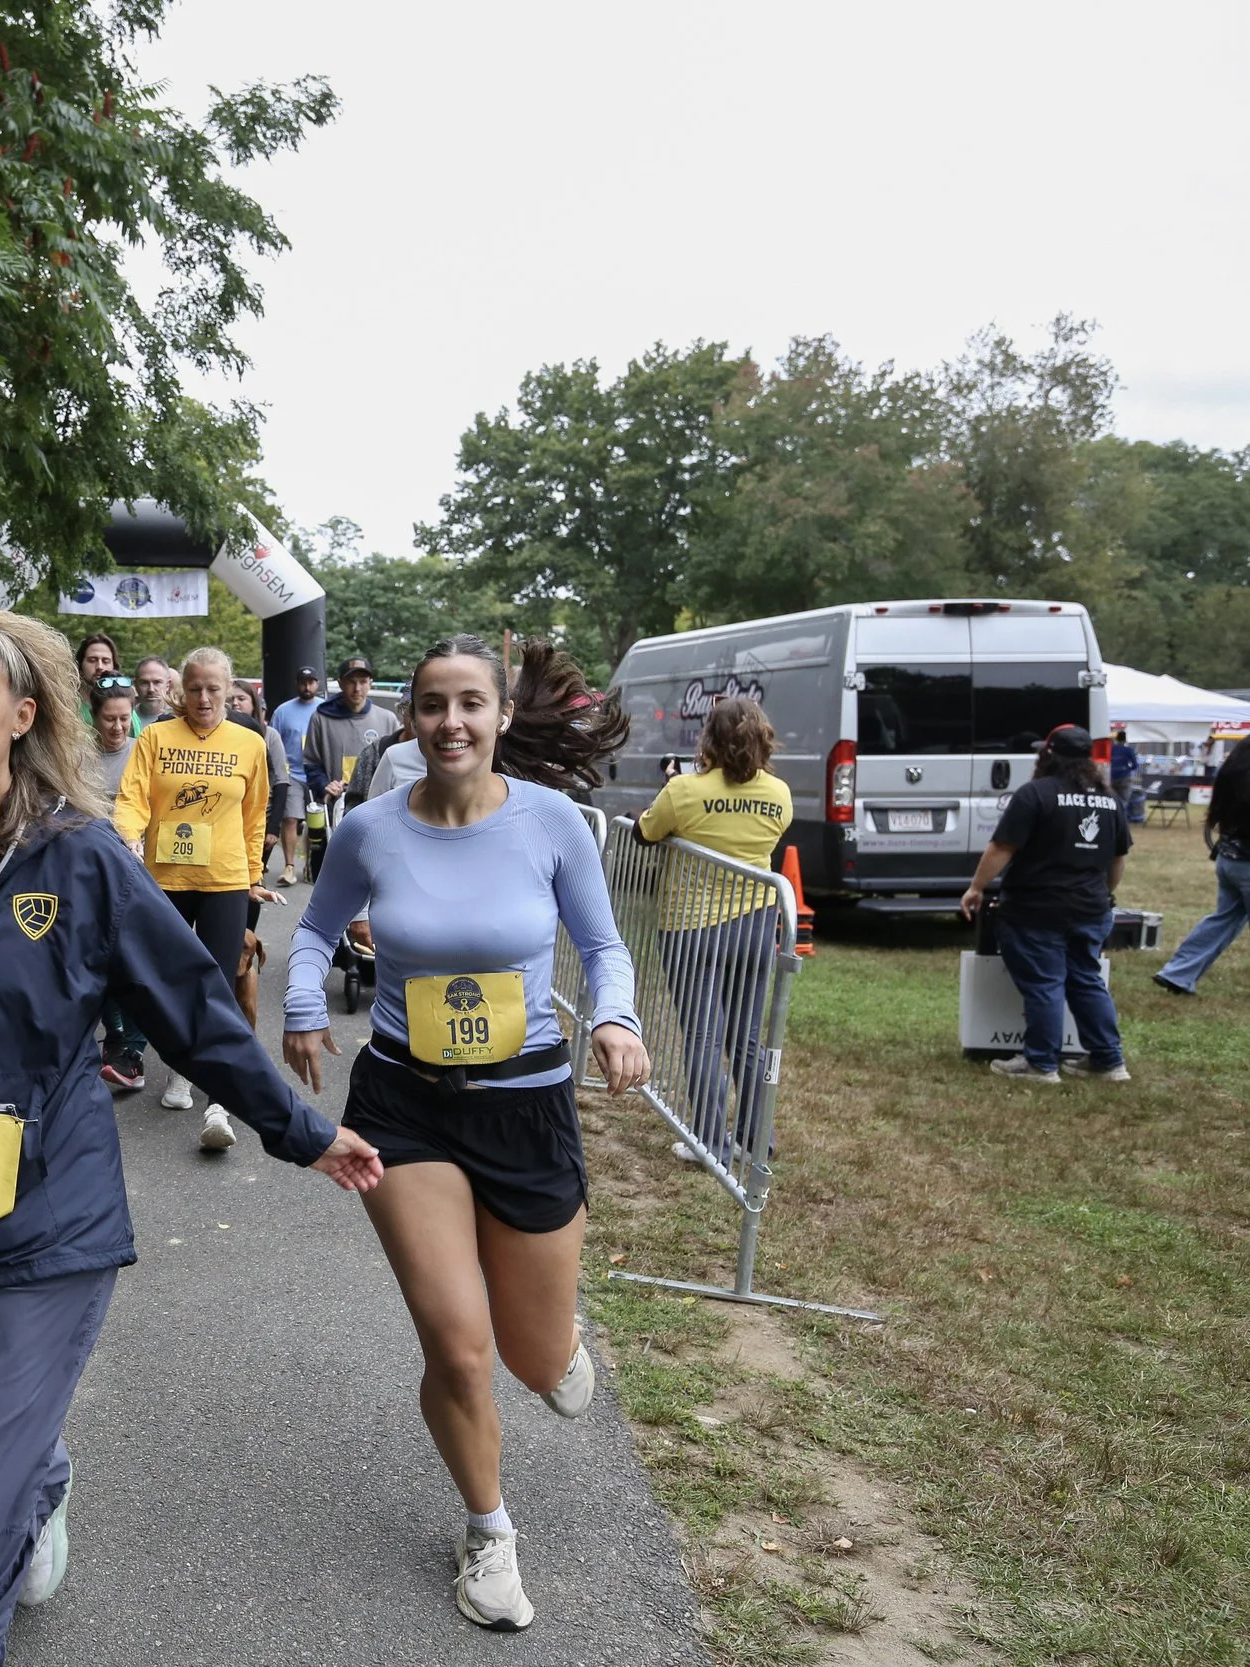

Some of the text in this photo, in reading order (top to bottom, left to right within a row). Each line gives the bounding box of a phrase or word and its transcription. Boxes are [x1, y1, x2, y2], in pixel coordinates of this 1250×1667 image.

[158, 747, 238, 767] LYNNFIELD
[161, 762, 233, 778] PIONEERS
[703, 798, 783, 819] VOLUNTEER
[1057, 793, 1117, 811] RACE CREW
[173, 841, 194, 855] 209
[446, 1016, 490, 1045] 199
[453, 1046, 494, 1055] DUFFY
